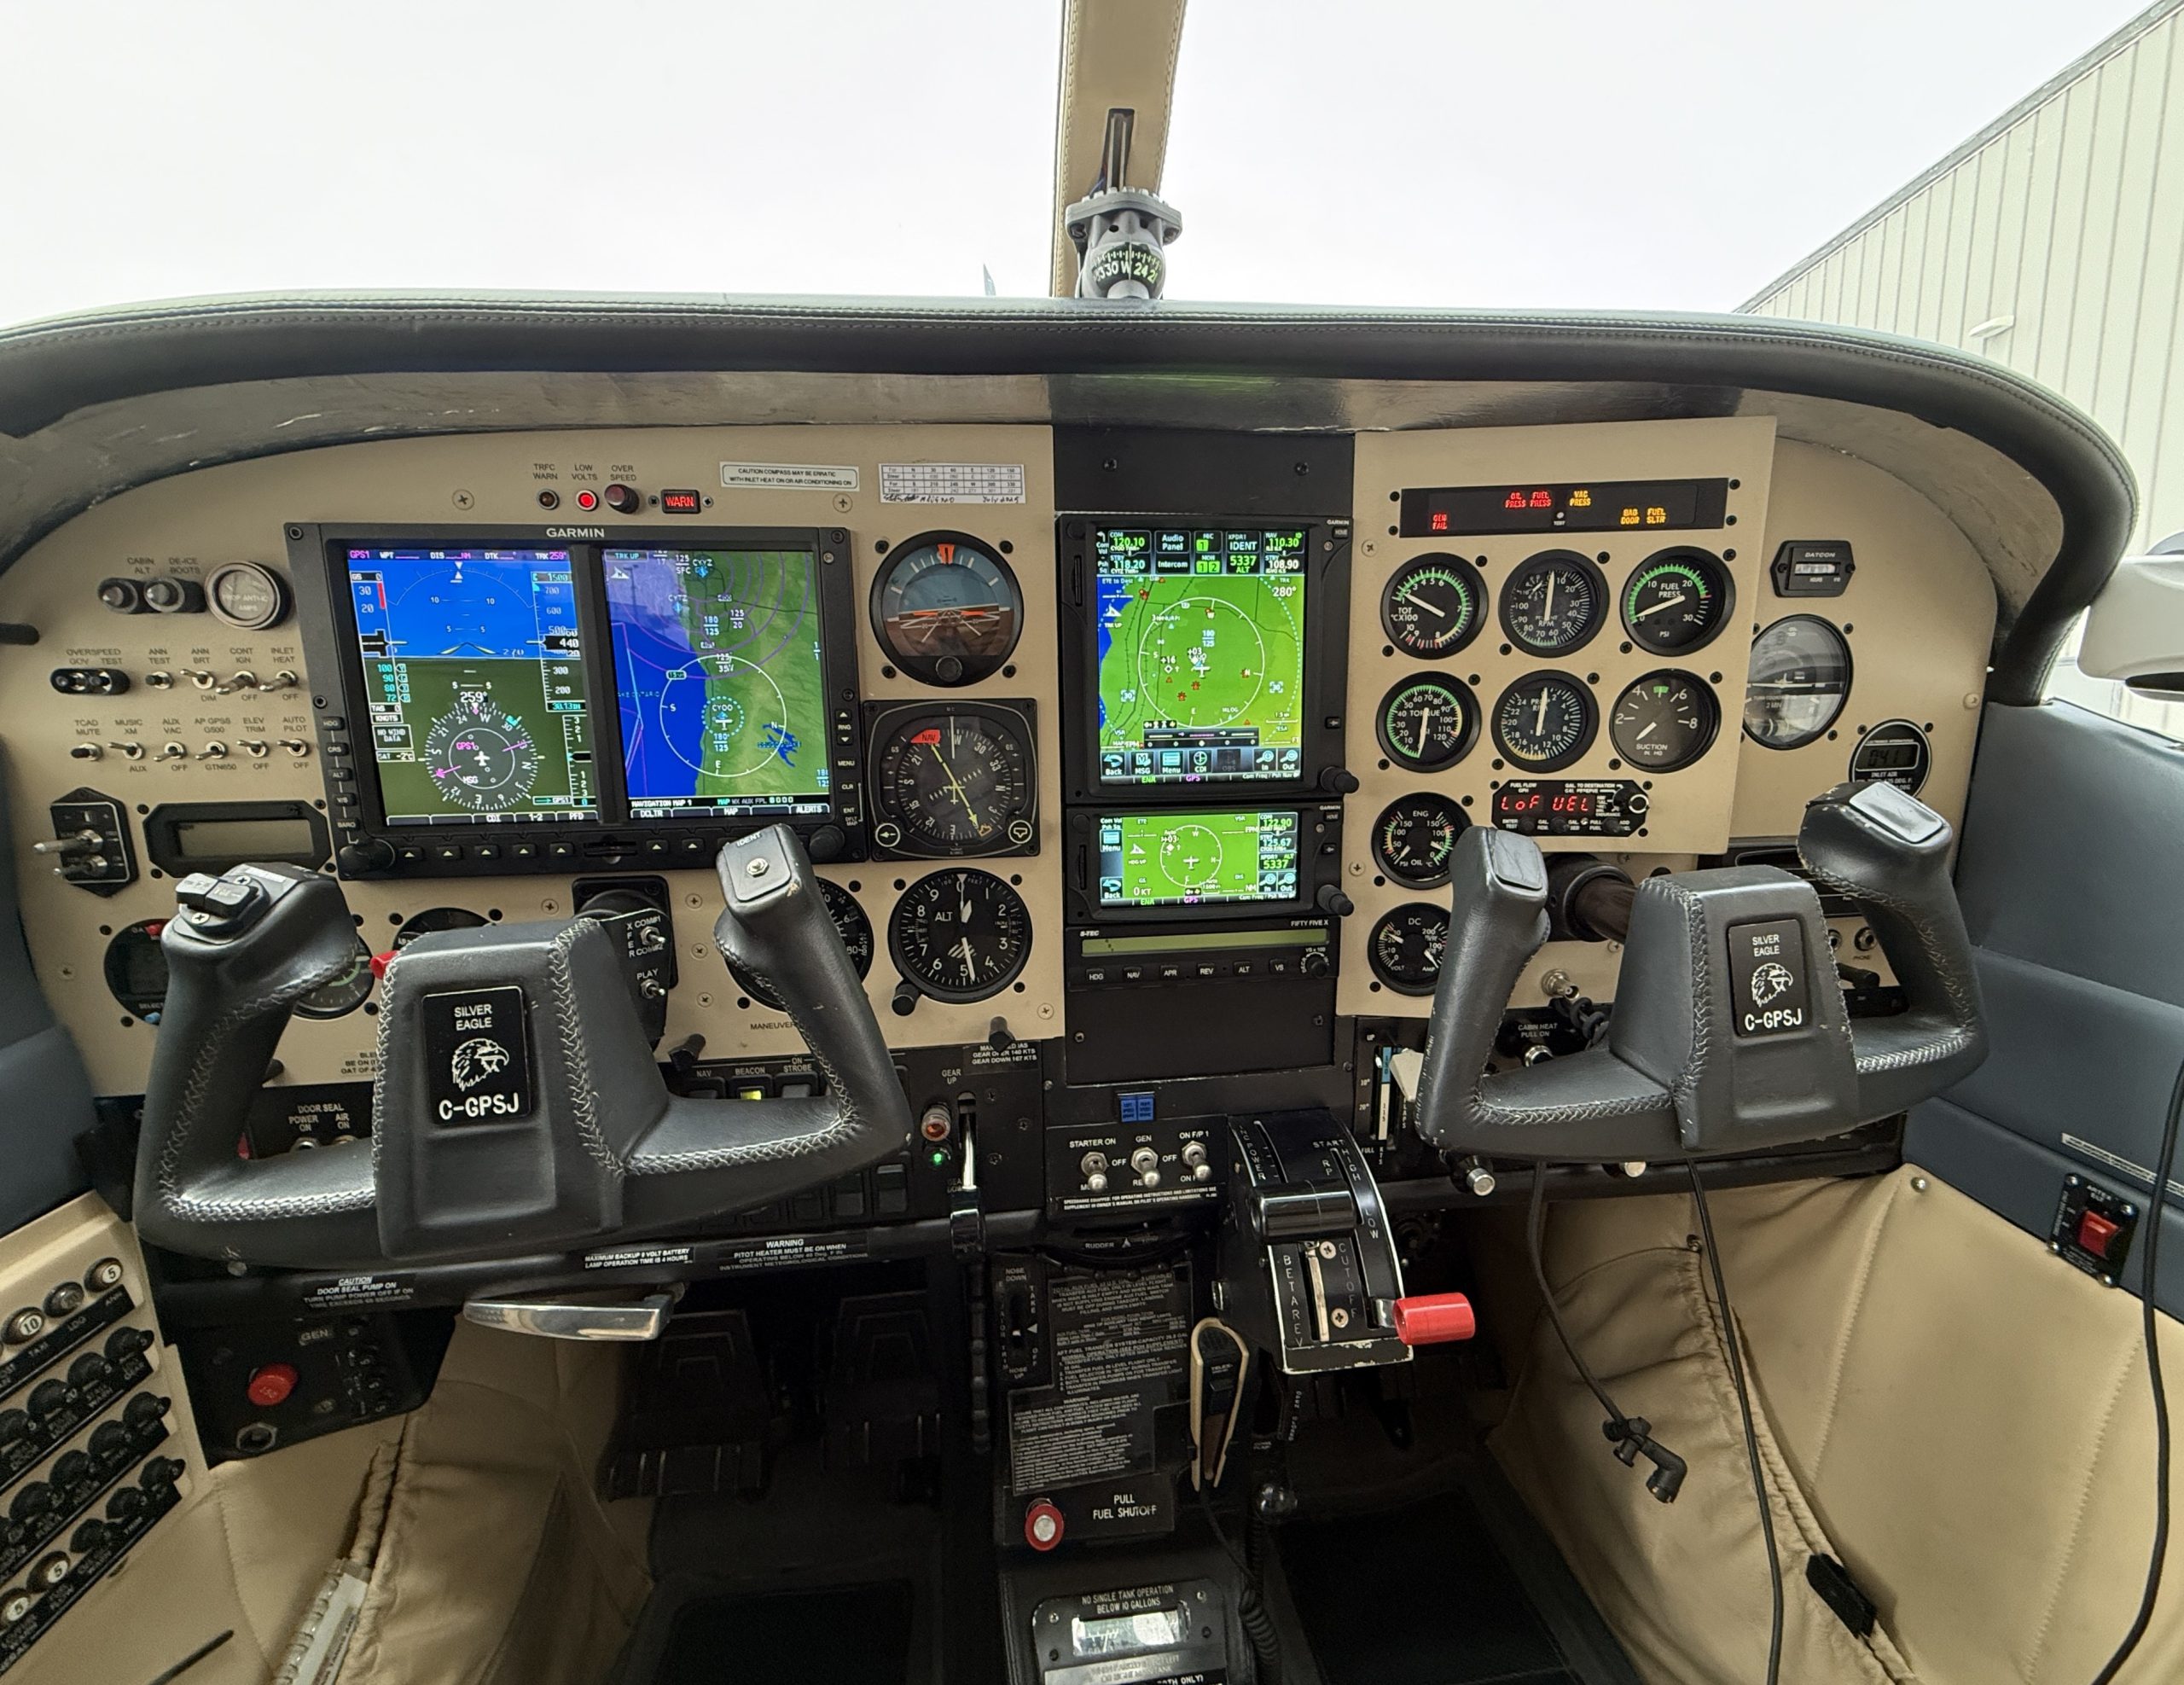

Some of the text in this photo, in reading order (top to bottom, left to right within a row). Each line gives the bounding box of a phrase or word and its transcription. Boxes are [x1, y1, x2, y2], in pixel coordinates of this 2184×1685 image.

[1574, 490, 1589, 498] VAC
[665, 497, 694, 507] WARN
[1530, 498, 1551, 508] PRESS
[1570, 497, 1591, 507] PRESS
[1621, 515, 1640, 525] DOOR
[1647, 514, 1665, 524] SLTR
[546, 527, 605, 537] GARMIN
[1114, 537, 1145, 547] 120.10
[1162, 534, 1183, 543] Audio
[1229, 542, 1257, 550] IDENT
[1229, 555, 1257, 566] 5337
[676, 567, 691, 575] SFC
[1273, 586, 1297, 597] 280°
[1660, 583, 1680, 591] FUEL
[1538, 619, 1554, 628] RPM
[1635, 742, 1668, 752] SUCTION
[486, 814, 502, 822] CDI
[568, 812, 584, 821] PFD
[1263, 860, 1288, 869] 5337
[934, 911, 953, 921] ALT
[1409, 917, 1421, 926] DC
[1751, 934, 1780, 946] SILVER
[1753, 945, 1780, 956] EAGLE
[1275, 963, 1284, 972] VS
[636, 968, 659, 980] PLAY
[1089, 972, 1104, 980] HDG
[454, 1003, 492, 1018] SILVER
[456, 1017, 492, 1031] EAGLE
[1744, 1011, 1804, 1031] C-GPSJ
[735, 1066, 765, 1076] BEACON
[783, 1064, 812, 1072] STROBE
[941, 1068, 961, 1078] GEAR
[297, 1103, 344, 1114] DOOR SEAL
[439, 1092, 520, 1121] C-GPSJ
[288, 1115, 319, 1124] POWER
[1069, 1139, 1103, 1148] STARTER
[1162, 1154, 1177, 1163] OFF
[766, 1239, 804, 1249] WARNING
[734, 1250, 754, 1258] PITOT
[756, 1248, 781, 1258] HEATER
[782, 1246, 803, 1256] MUST
[815, 1245, 825, 1253] ON
[826, 1243, 846, 1252] WHEN
[338, 1276, 373, 1286] CAUTION
[317, 1287, 340, 1295] DOOR
[1113, 1494, 1135, 1504] PULL
[1093, 1505, 1157, 1519] FUEL SHUTOFF
[1082, 1585, 1174, 1604] NO SINGLE TANK OPERATION
[1097, 1602, 1119, 1614] BELOW
[1130, 1597, 1160, 1609] GALLONS
